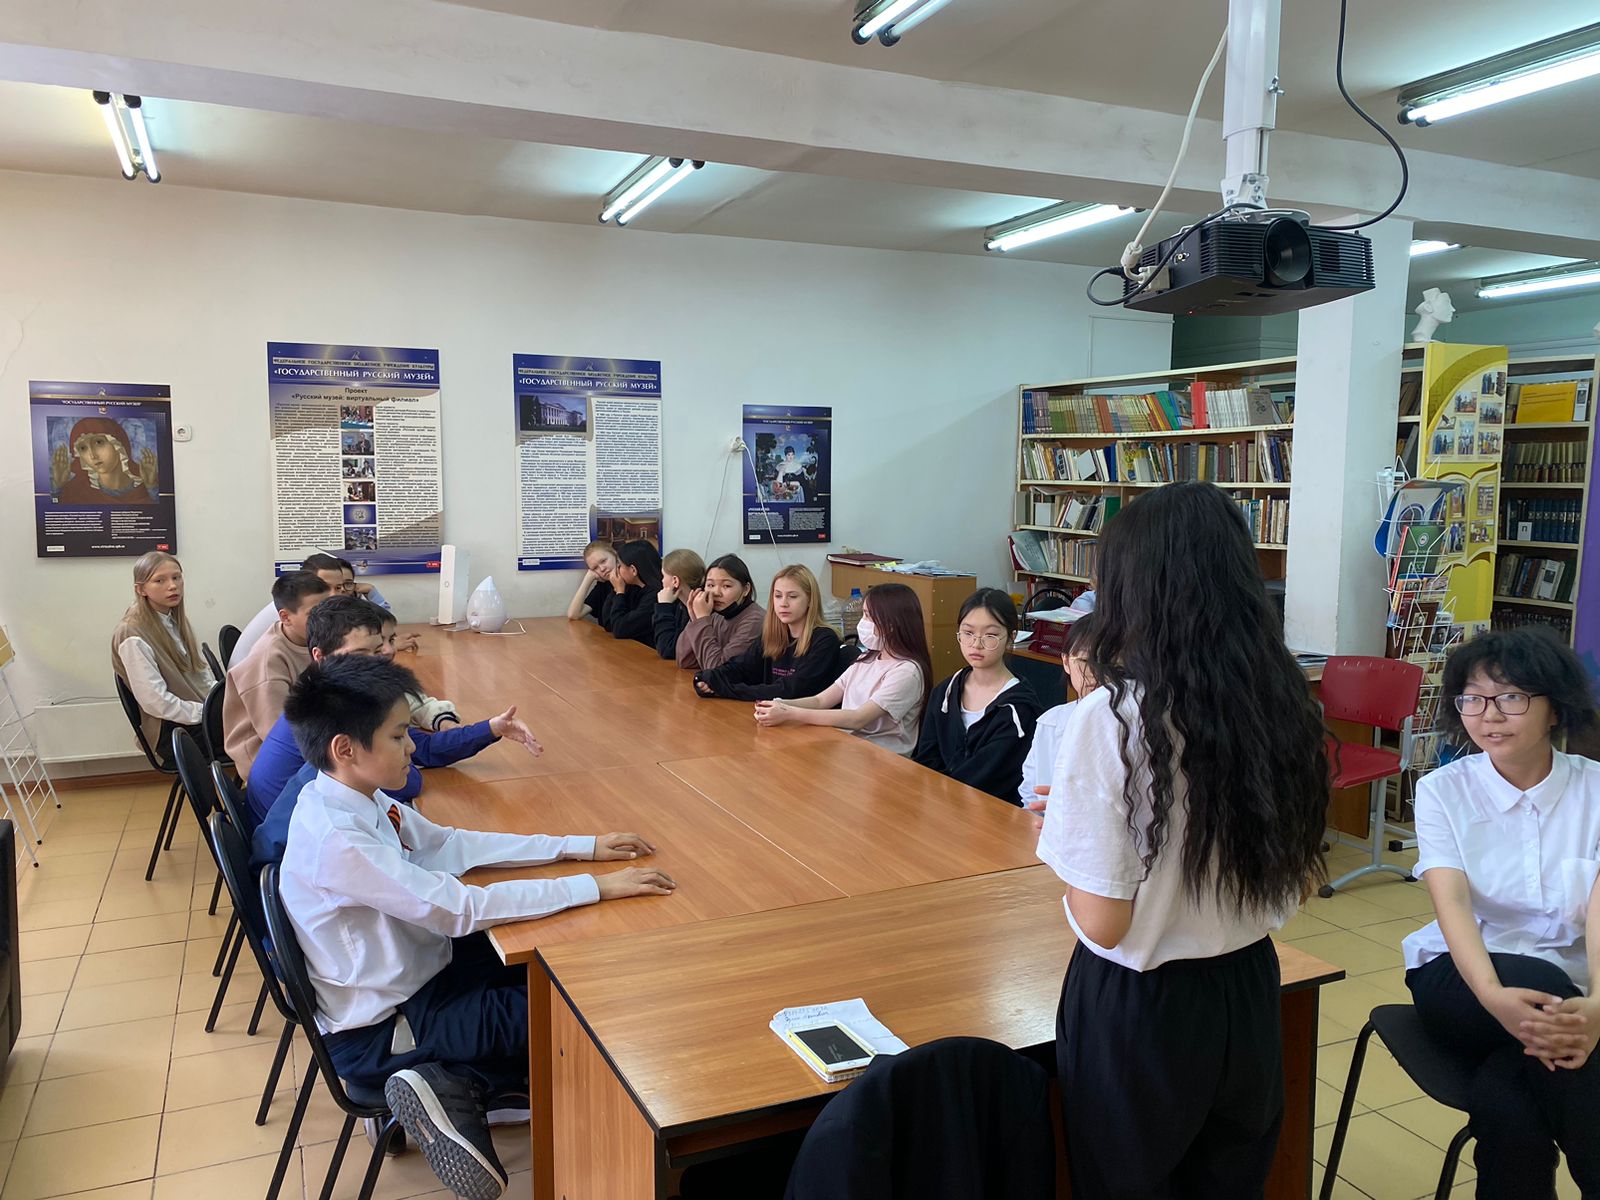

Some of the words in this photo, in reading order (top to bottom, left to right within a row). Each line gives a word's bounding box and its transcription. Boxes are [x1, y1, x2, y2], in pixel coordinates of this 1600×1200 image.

[274, 367, 359, 378] «ГОСУДАРСТВЕННЫЙ
[363, 370, 400, 379] РУССКИЙ
[403, 372, 434, 380] МУЗЕЙ»
[595, 381, 628, 389] РУССКИЙ
